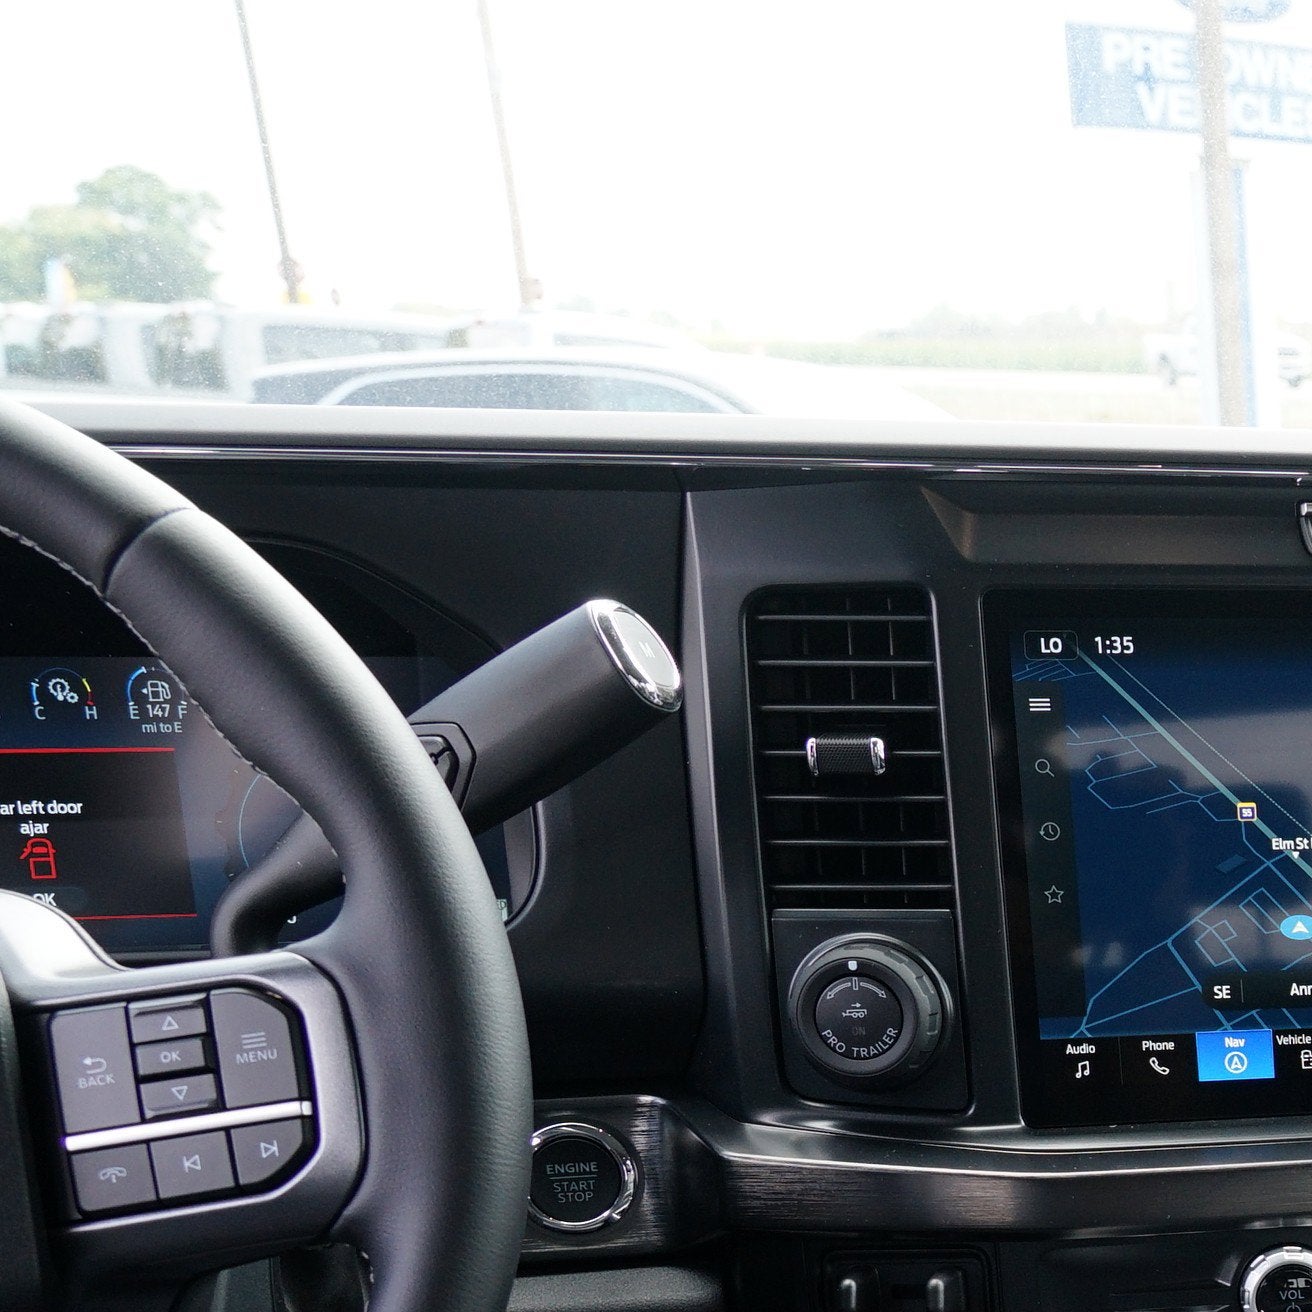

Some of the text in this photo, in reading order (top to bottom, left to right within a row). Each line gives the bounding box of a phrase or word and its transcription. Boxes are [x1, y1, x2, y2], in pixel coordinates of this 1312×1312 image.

[1101, 31, 1194, 81] PRE
[1040, 636, 1134, 655] LO 1:35
[34, 705, 98, 720] C H
[129, 704, 188, 720] E 147 F
[142, 722, 183, 733] mi to E
[0, 800, 83, 815] ar left door
[20, 820, 49, 837] ajar
[1271, 838, 1295, 851] Elm
[1295, 838, 1310, 851] St
[1213, 985, 1231, 1000] SE
[821, 1027, 899, 1058] PRO TRAILER
[1142, 1039, 1175, 1051] Phone
[1224, 1037, 1246, 1049] Nav
[1276, 1033, 1312, 1046] Vehicle
[1066, 1043, 1096, 1055] Audio
[160, 1051, 181, 1063] OK
[235, 1048, 278, 1066] MENU
[78, 1074, 116, 1090] BACK
[546, 1161, 599, 1175] ENGINE
[553, 1180, 596, 1192] START
[558, 1191, 594, 1203] STOP
[1278, 1289, 1305, 1300] VOL
